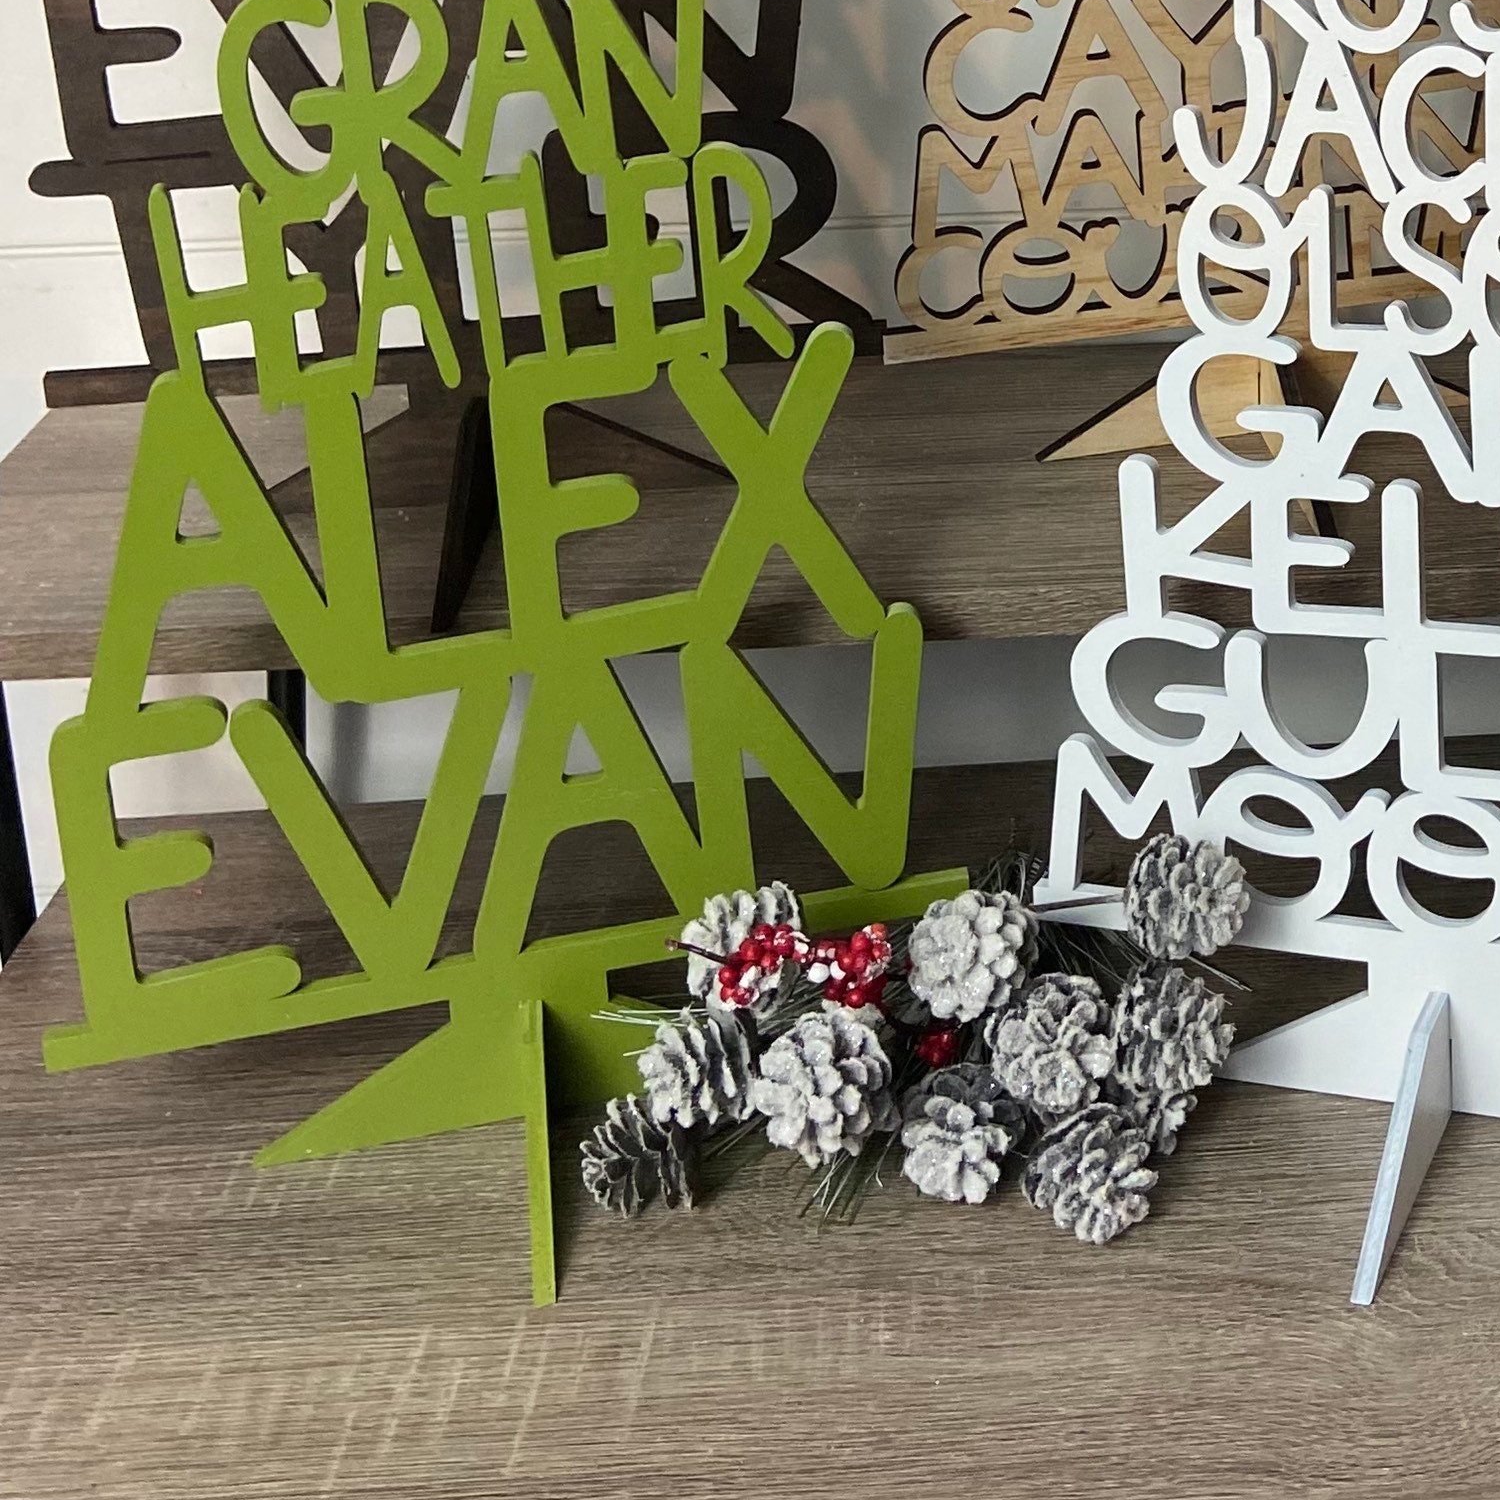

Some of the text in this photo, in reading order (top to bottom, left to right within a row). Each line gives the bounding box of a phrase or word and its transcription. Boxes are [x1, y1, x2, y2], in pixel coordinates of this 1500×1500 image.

[149, 141, 795, 410] HEATHER
[86, 321, 888, 708] ALEX
[48, 601, 924, 1022] EVAN
